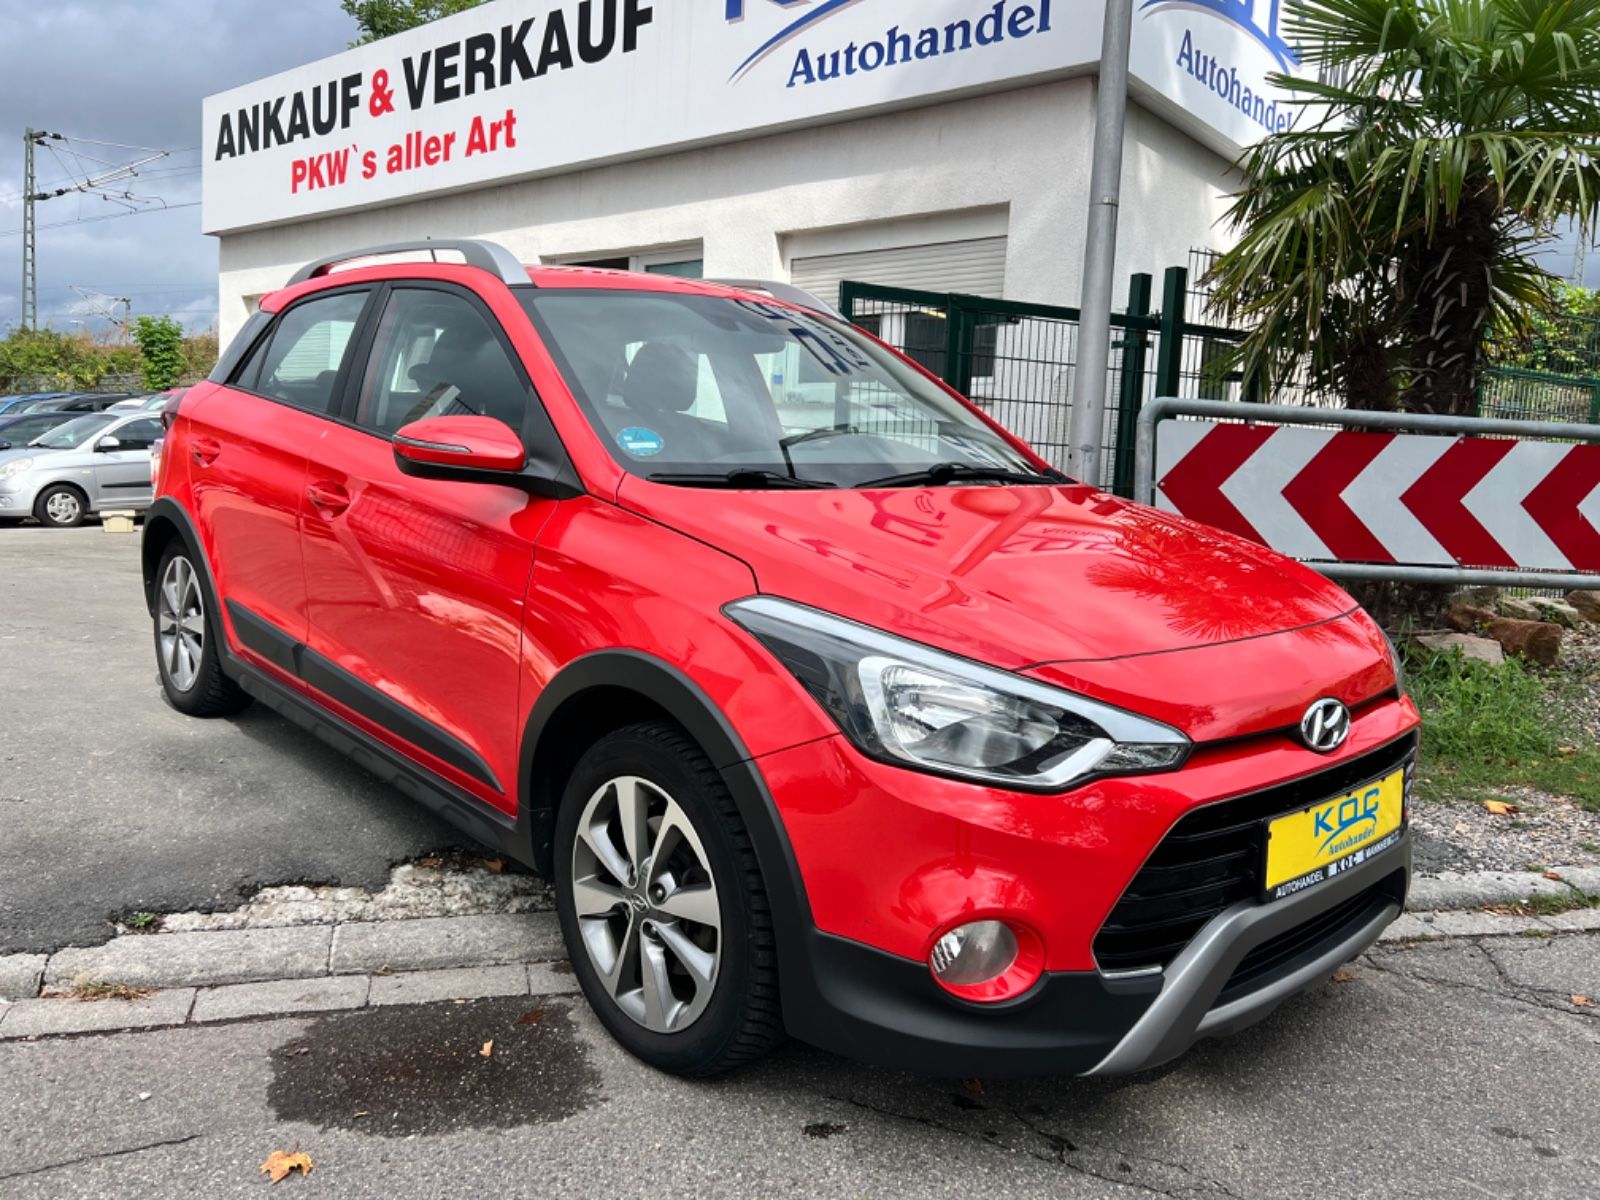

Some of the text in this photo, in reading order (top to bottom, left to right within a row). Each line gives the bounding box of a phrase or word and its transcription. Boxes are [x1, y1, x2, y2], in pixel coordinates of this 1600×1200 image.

[215, 0, 653, 161] ANKAUF & VERKAUF
[785, 0, 1051, 88] Autohandel
[386, 131, 456, 174] aller
[464, 108, 517, 157] Art
[1276, 869, 1325, 899] AUTOHANDEL
